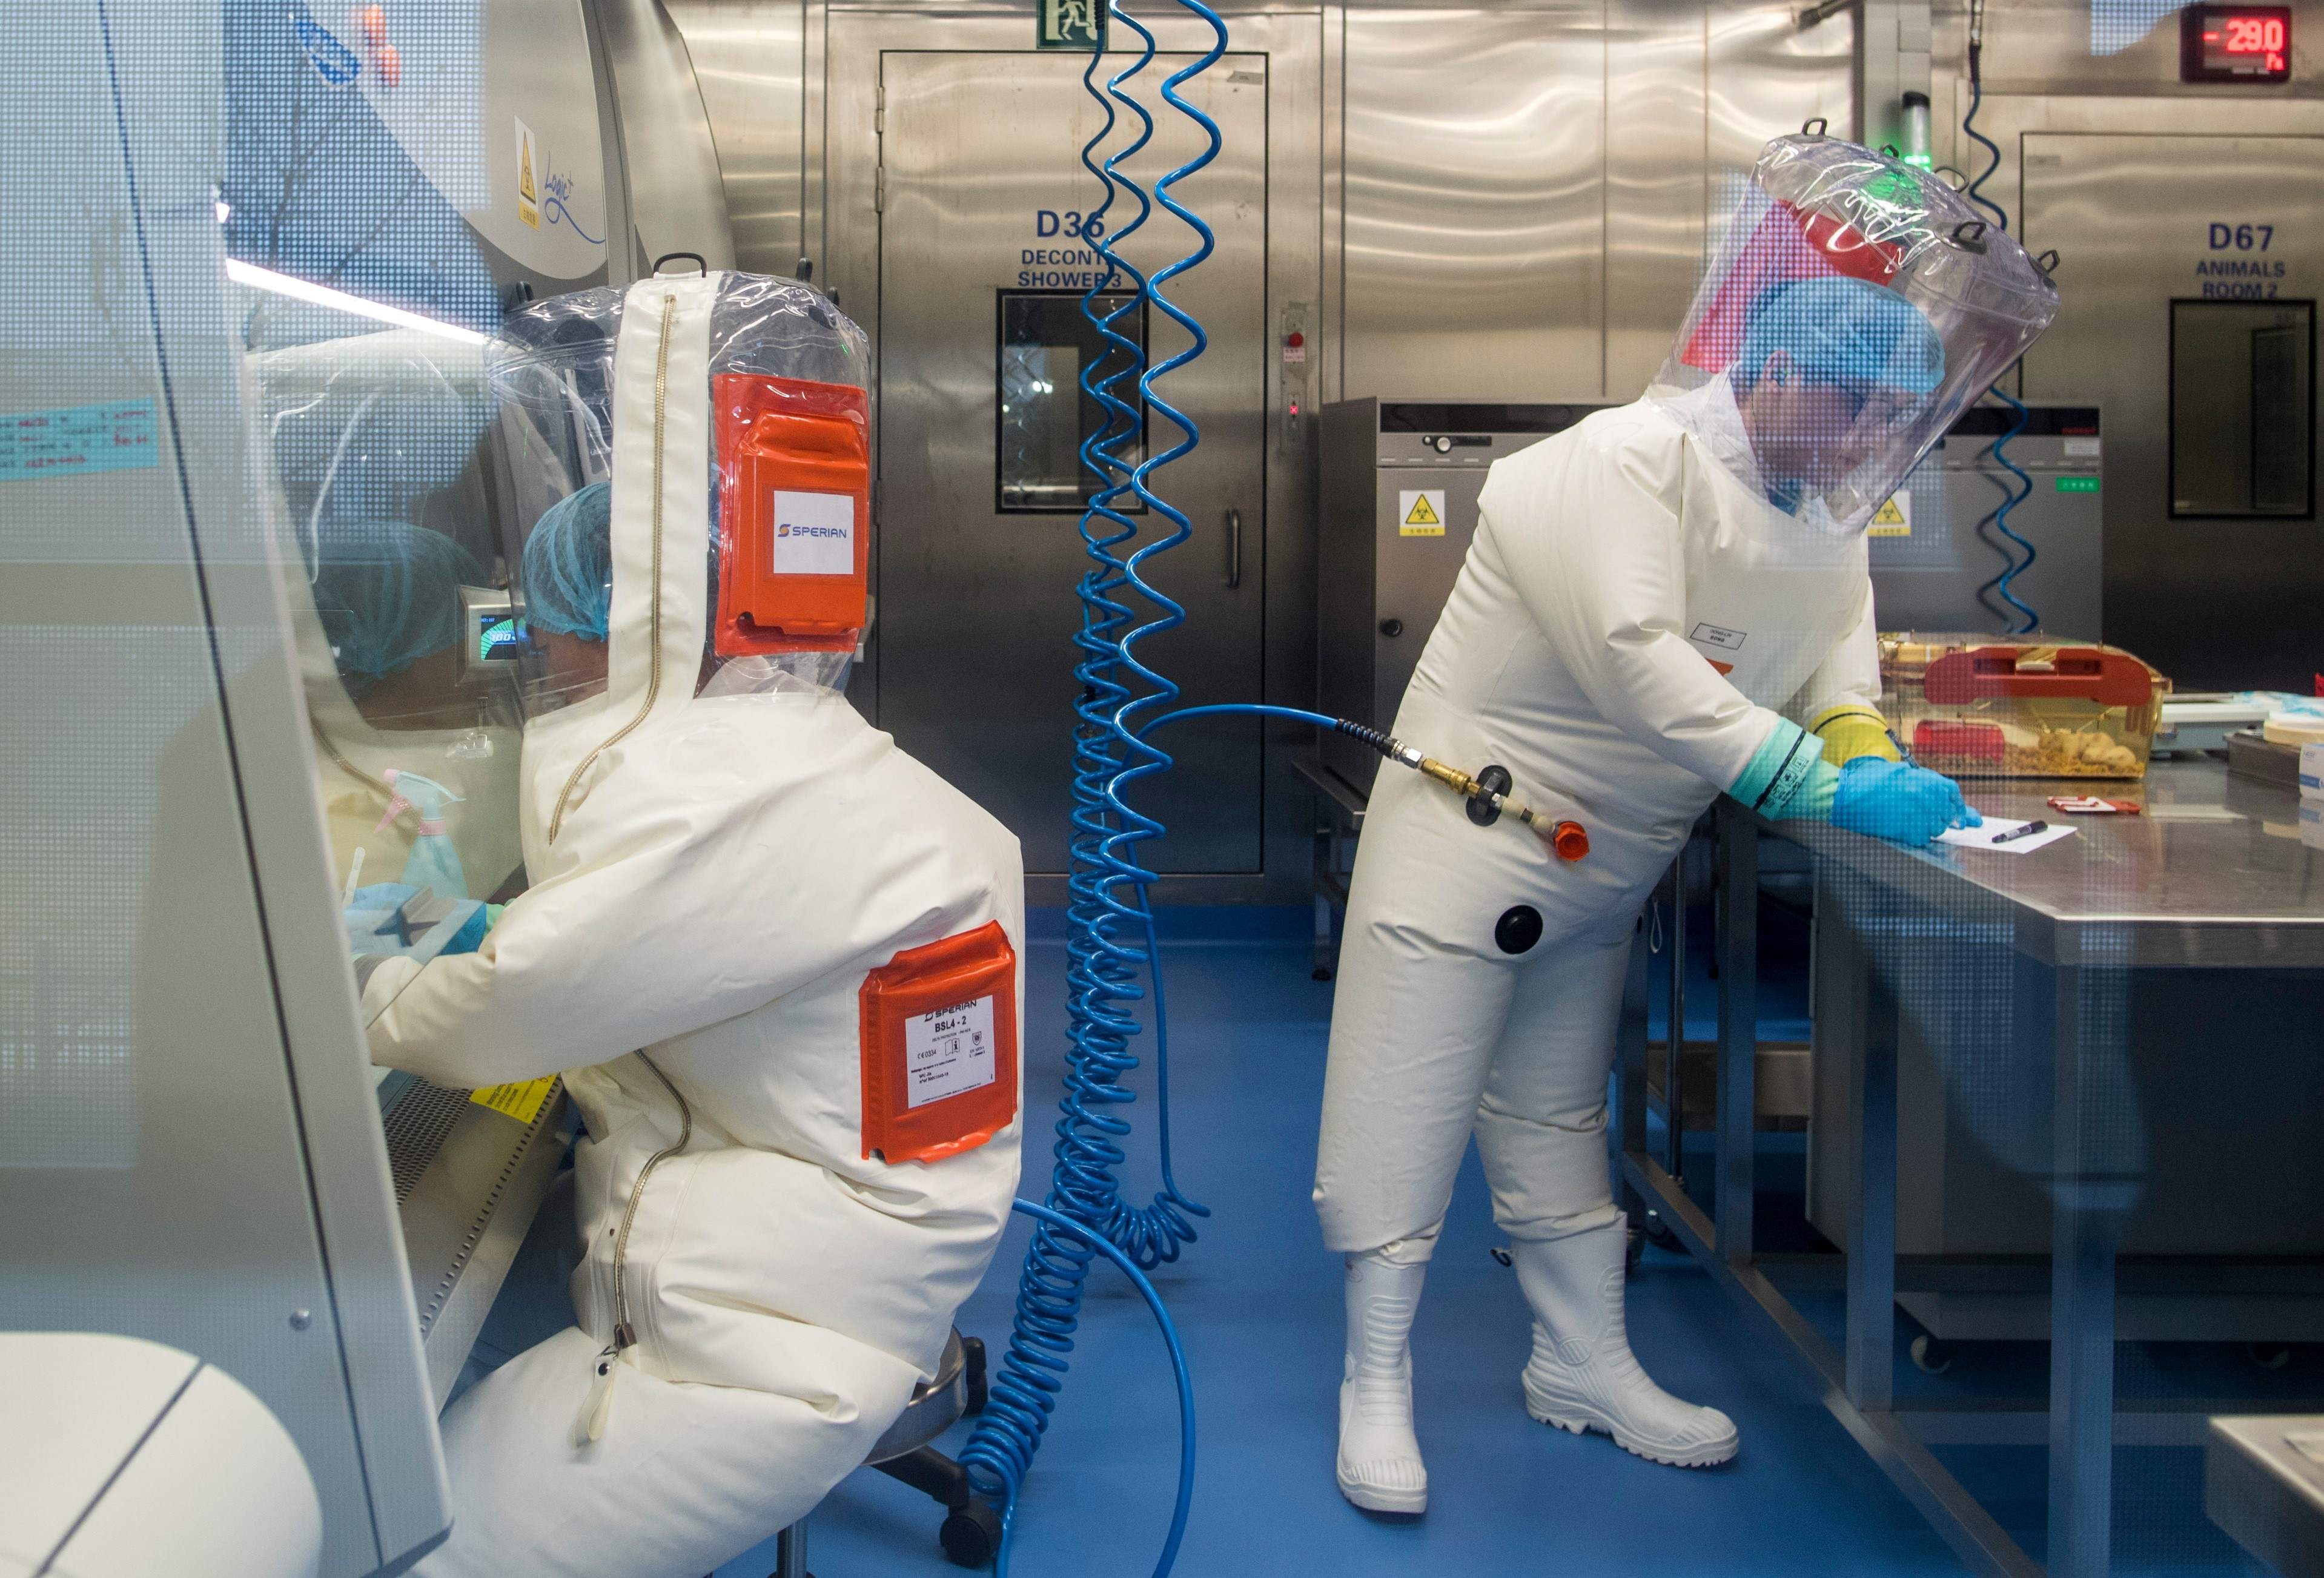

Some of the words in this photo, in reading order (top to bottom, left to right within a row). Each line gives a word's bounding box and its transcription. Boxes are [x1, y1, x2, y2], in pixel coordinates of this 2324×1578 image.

[1038, 210, 1104, 237] D36
[2210, 223, 2273, 251] D67
[2196, 260, 2286, 277] ANIMALS
[1112, 273, 1121, 287] 3
[2203, 281, 2262, 300] ROOM
[2268, 282, 2278, 300] 2
[792, 526, 847, 538] SPERIAN
[935, 1000, 976, 1018] SPERIAN
[935, 1018, 955, 1032] BSL4
[962, 1015, 967, 1025] 2
